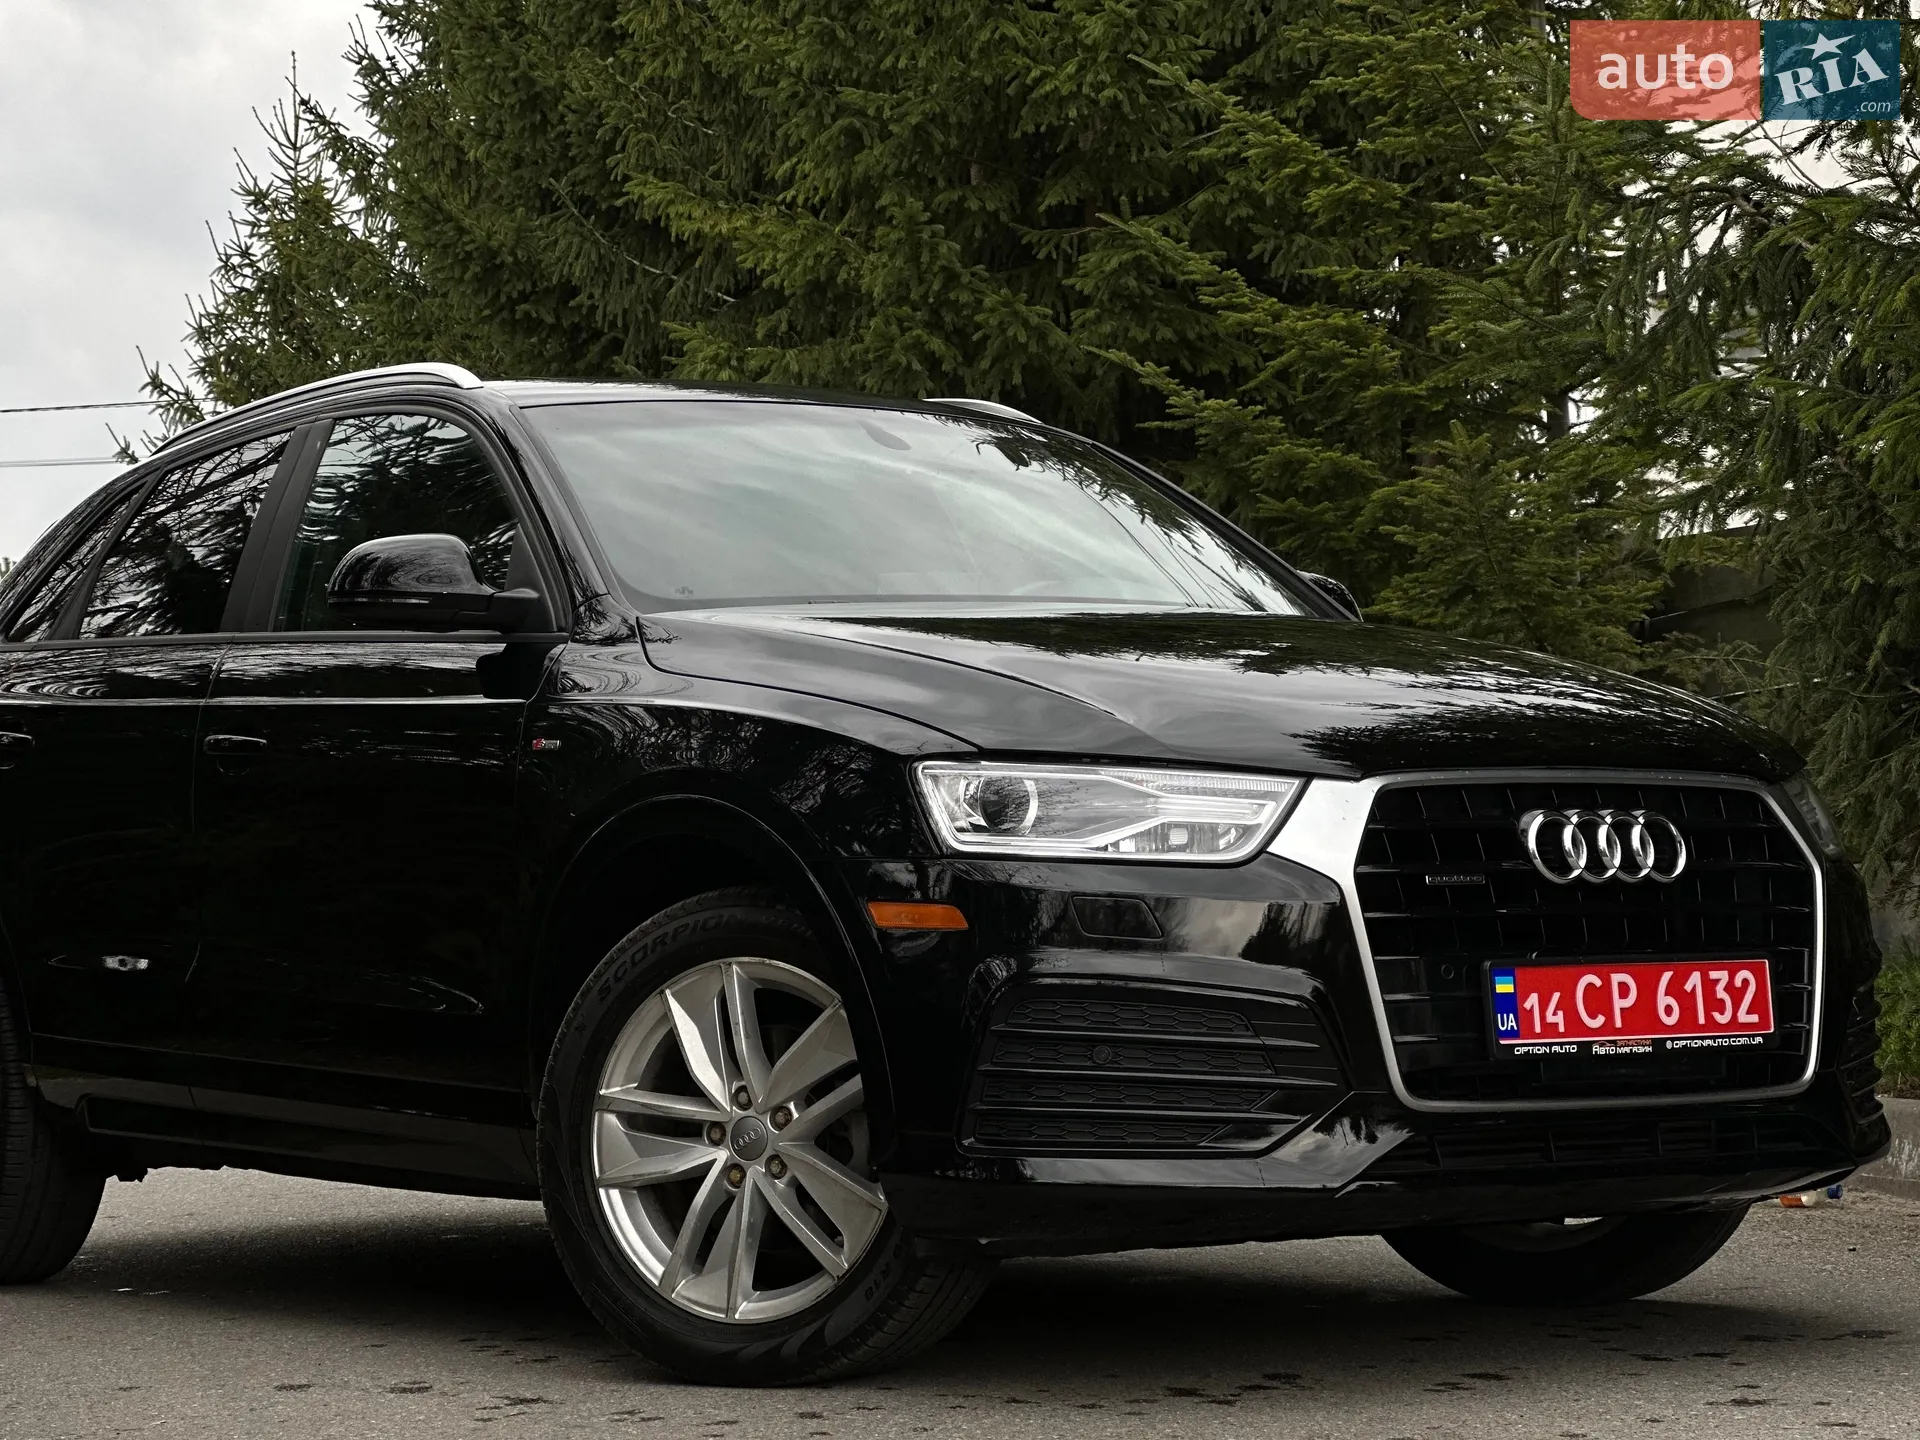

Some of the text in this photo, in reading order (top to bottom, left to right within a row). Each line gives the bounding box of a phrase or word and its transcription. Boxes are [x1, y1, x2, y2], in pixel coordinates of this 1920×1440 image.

[597, 914, 748, 1002] SCORPION
[1497, 1013, 1518, 1031] UA
[1522, 969, 1759, 1034] 14 CP 6132
[1551, 1045, 1578, 1053] AUTO
